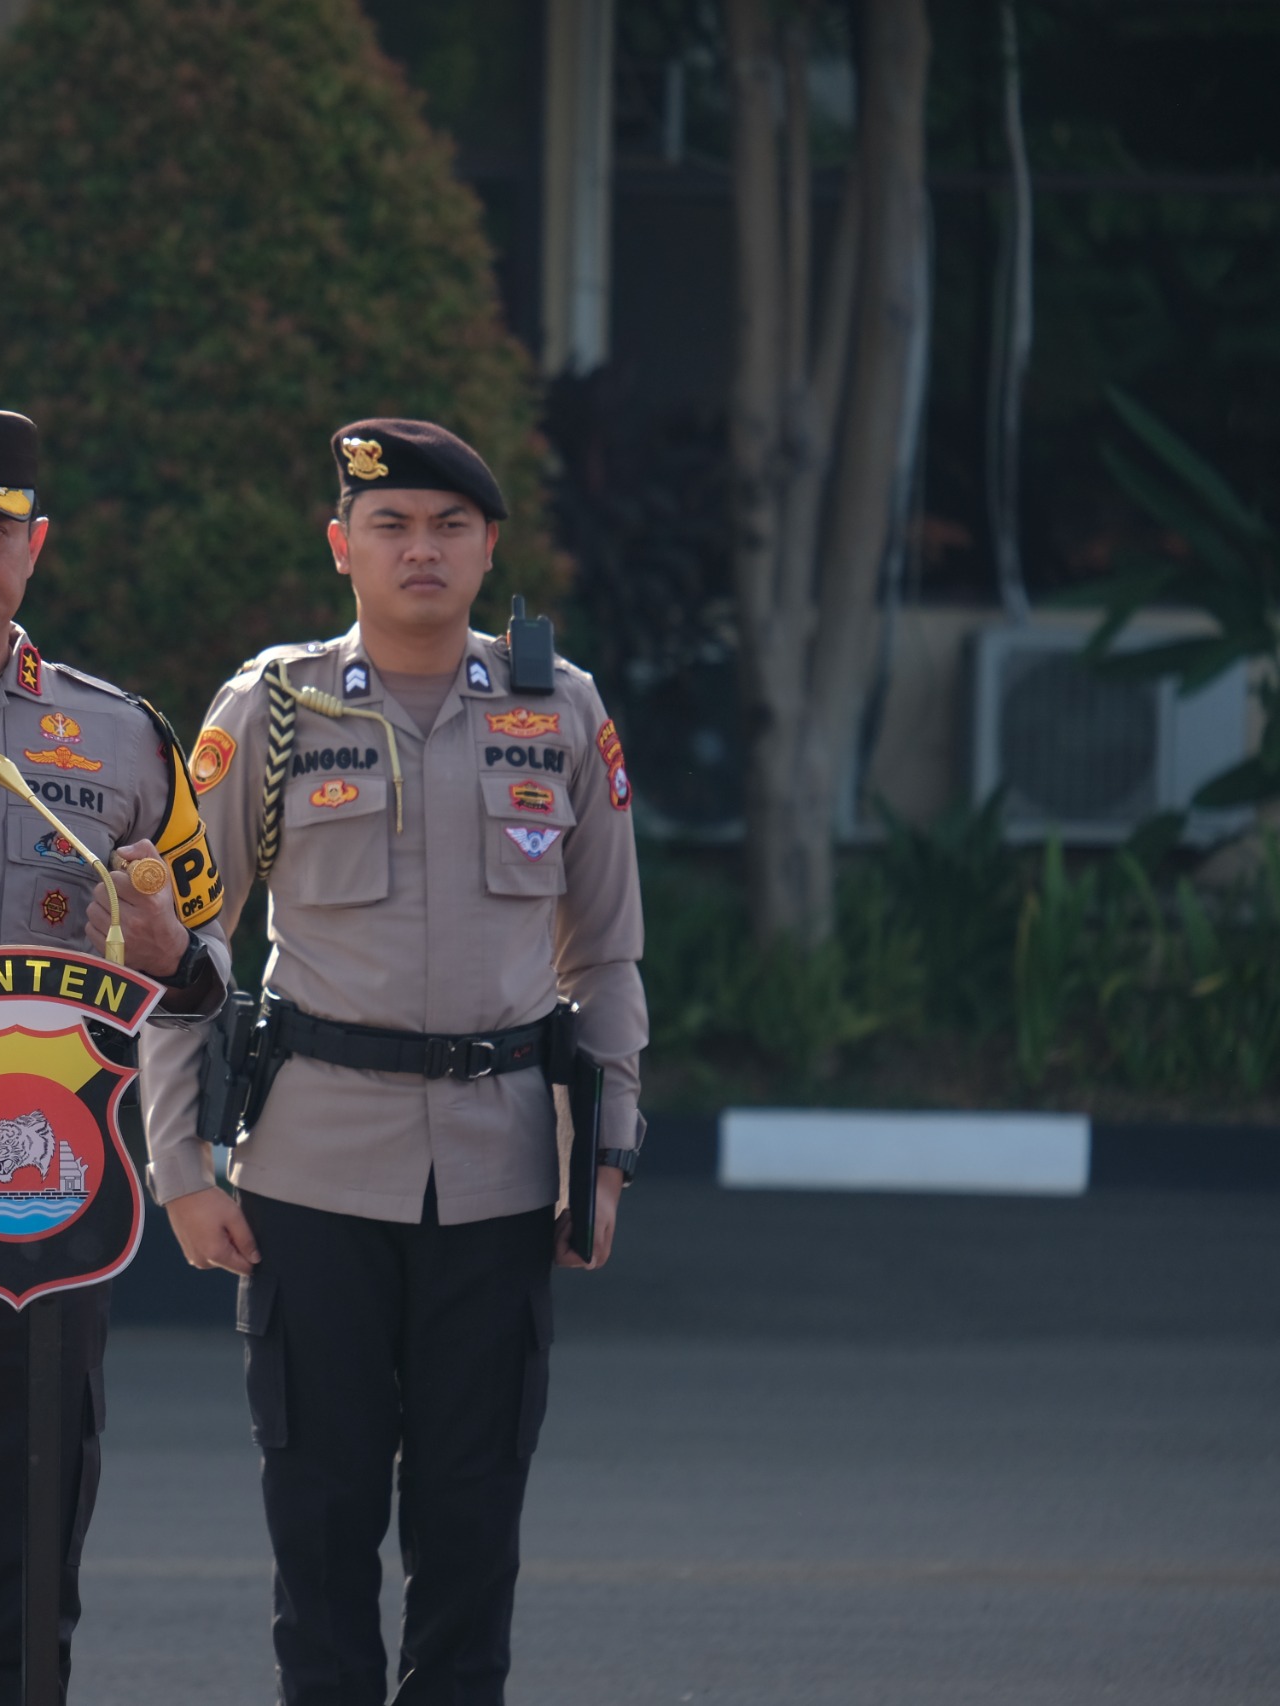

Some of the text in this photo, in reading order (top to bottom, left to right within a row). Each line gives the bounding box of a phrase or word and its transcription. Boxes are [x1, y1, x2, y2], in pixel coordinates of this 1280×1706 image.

[292, 747, 379, 778] ANGGI.P
[485, 746, 565, 773] POLRI
[24, 779, 104, 814] POLRI
[182, 895, 204, 917] OPS
